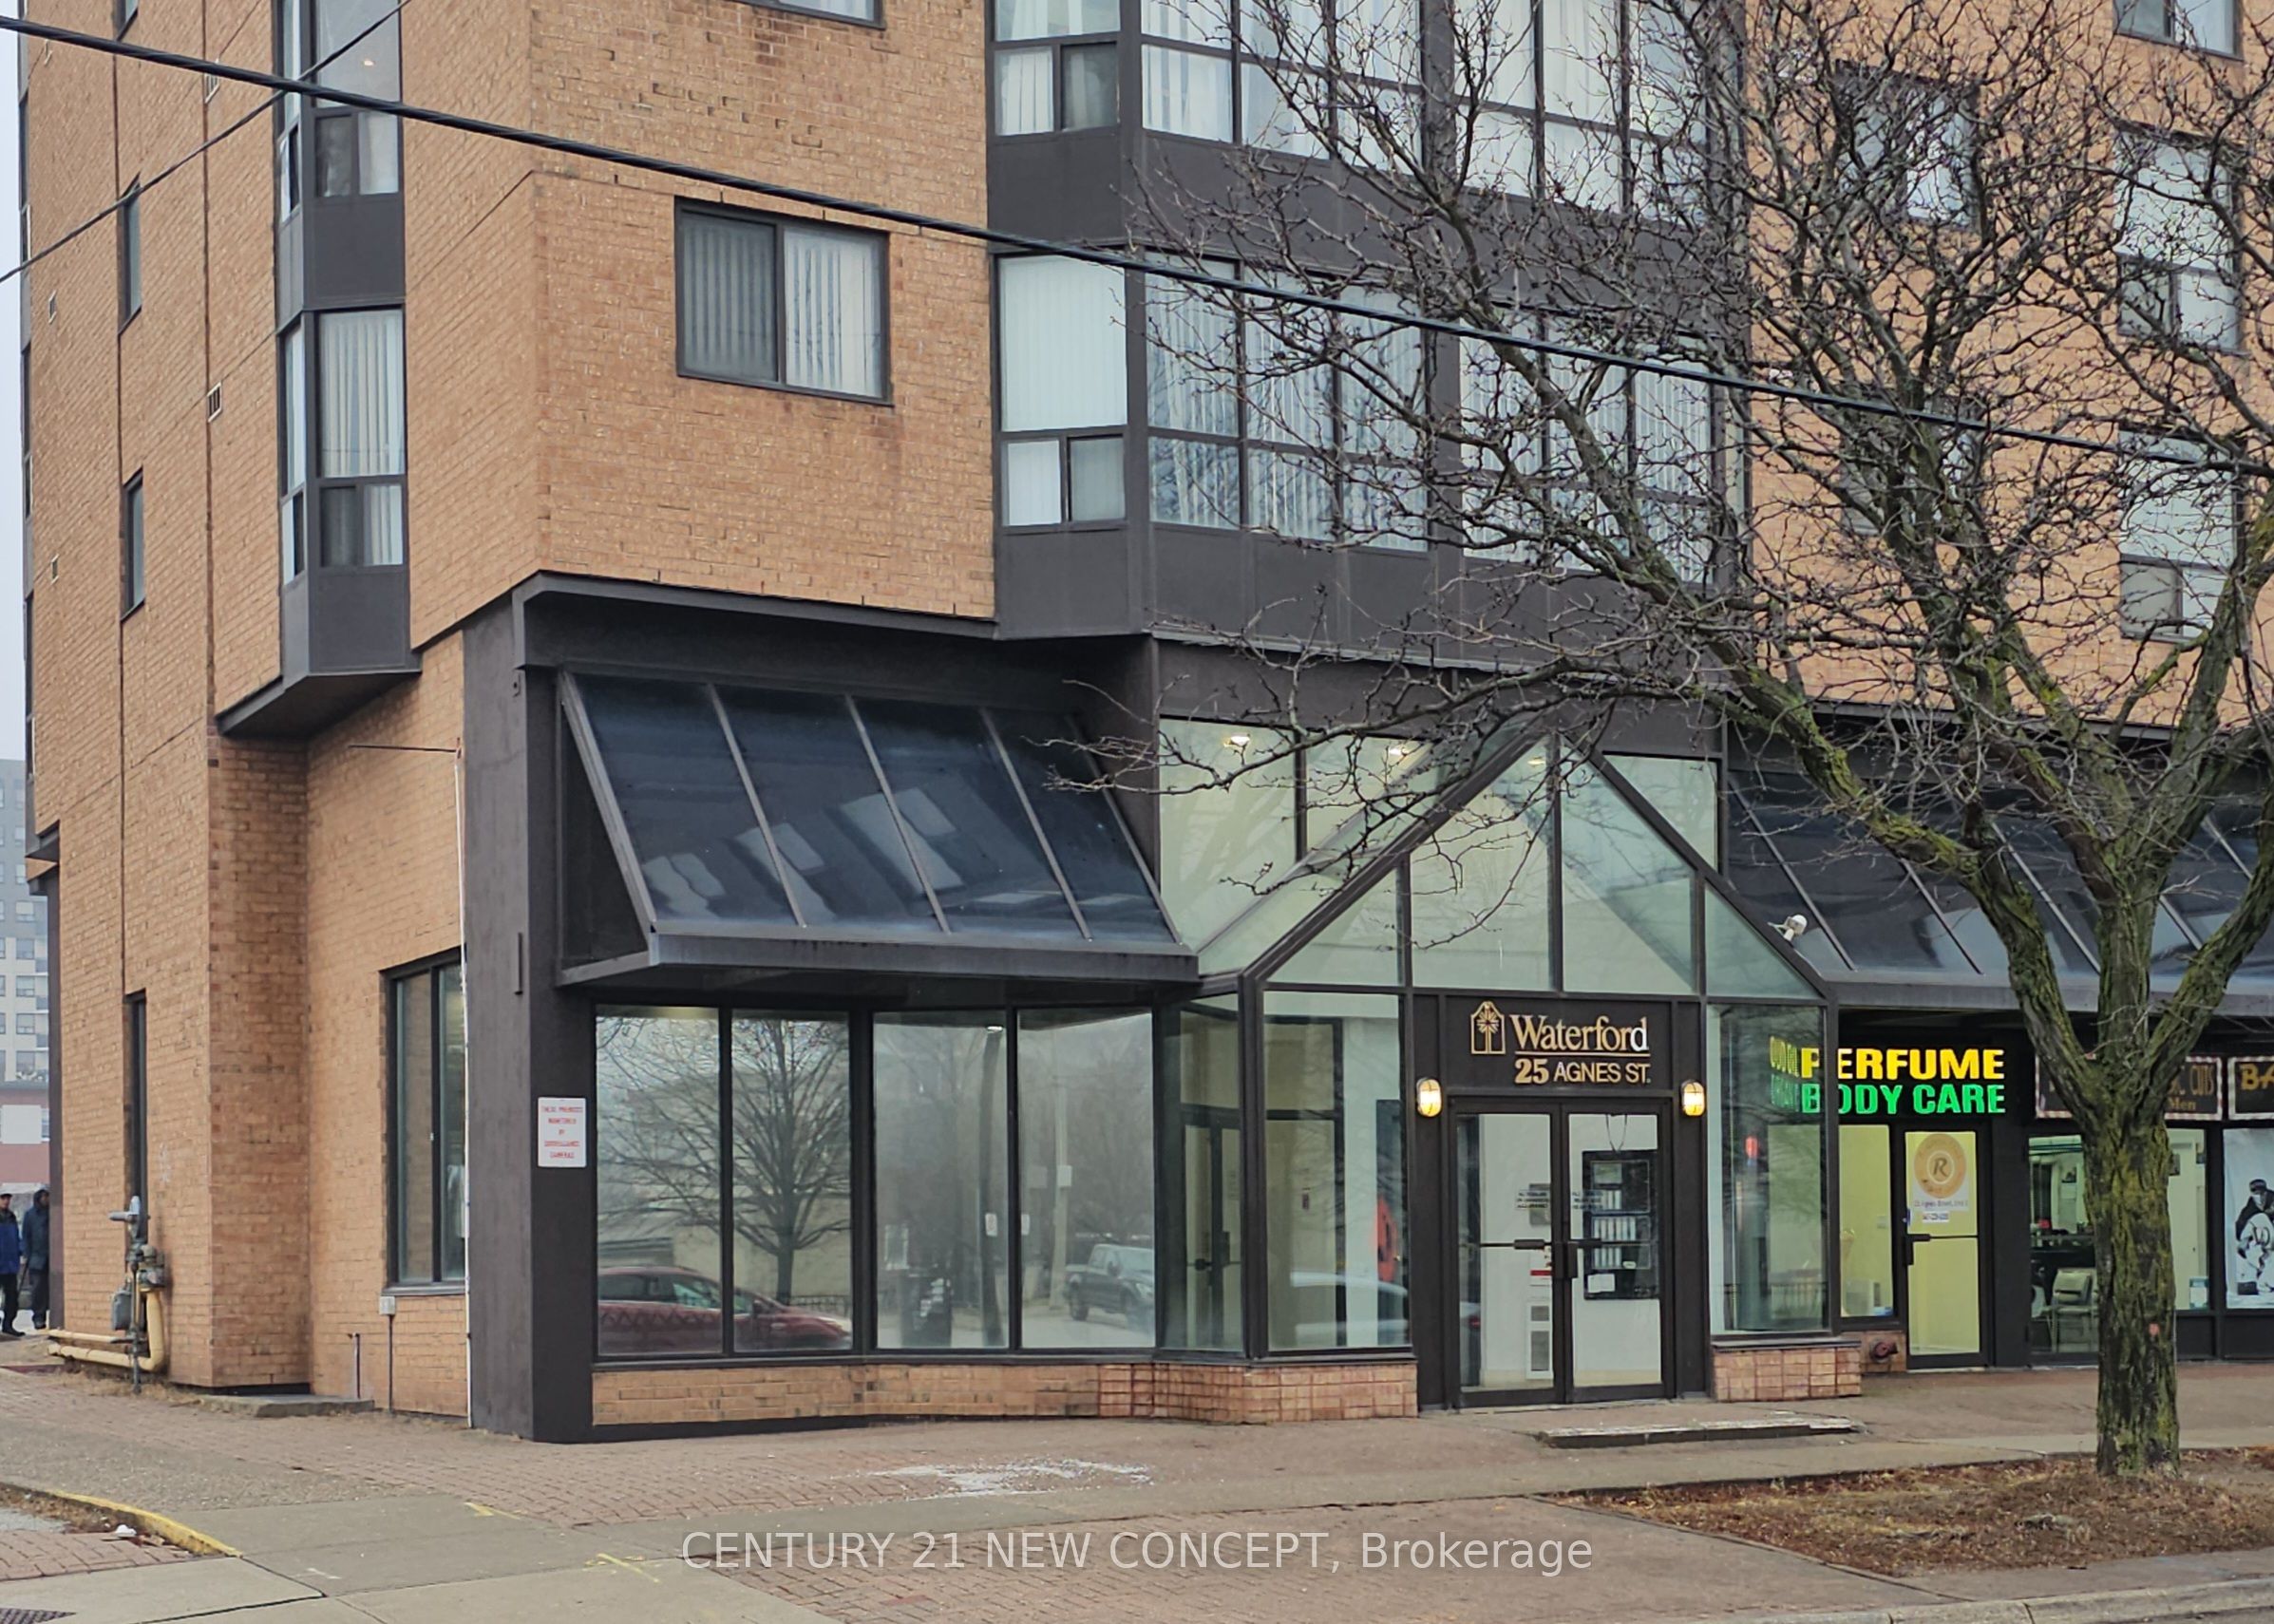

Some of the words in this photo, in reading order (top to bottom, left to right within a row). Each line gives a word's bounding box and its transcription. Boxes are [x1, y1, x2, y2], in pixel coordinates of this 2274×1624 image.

[1508, 1014, 1649, 1052] Waterford
[1514, 1058, 1550, 1085] 25
[1553, 1062, 1621, 1084] AGNES
[1624, 1062, 1651, 1085] ST.
[1801, 1048, 2004, 1080] PERFUME
[1912, 1084, 2006, 1114] CARE
